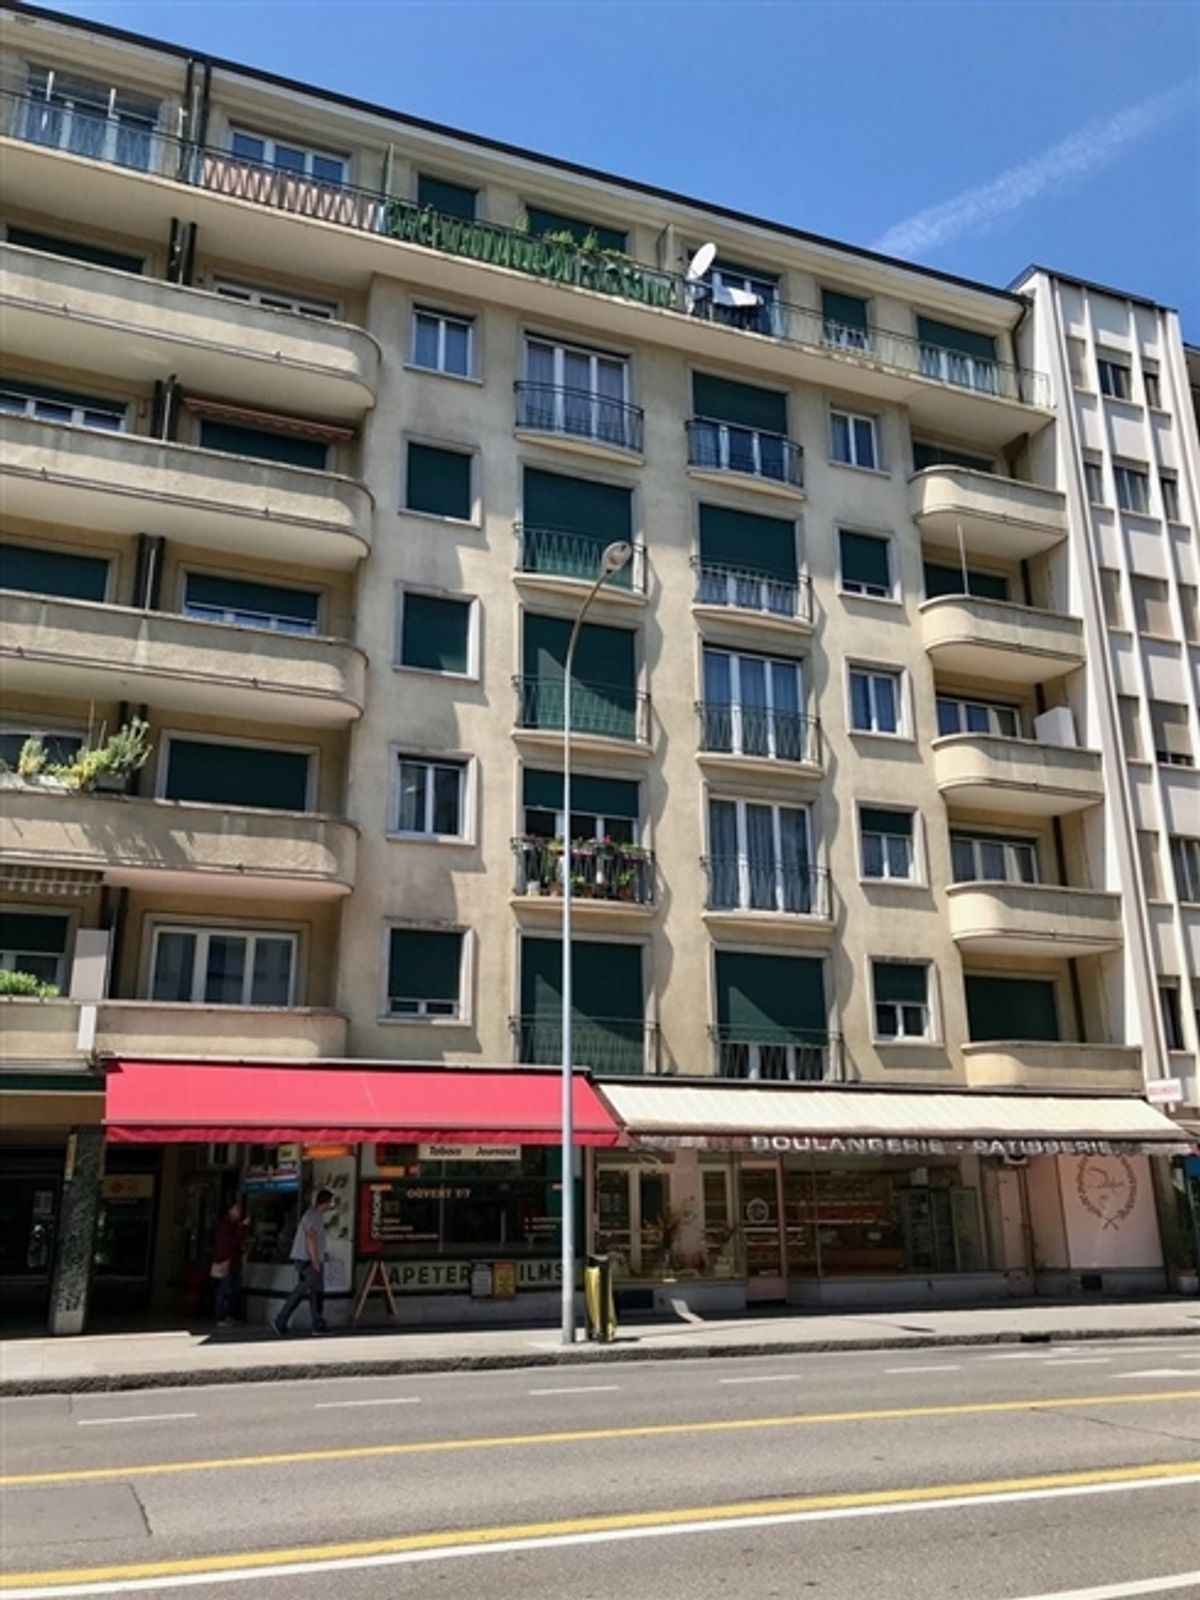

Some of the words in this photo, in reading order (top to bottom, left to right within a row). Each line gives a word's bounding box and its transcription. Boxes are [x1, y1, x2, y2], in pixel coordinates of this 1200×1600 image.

[751, 1135, 944, 1154] BOULANGERIE
[388, 1264, 471, 1285] APETER
[520, 1263, 563, 1282] ILMS
